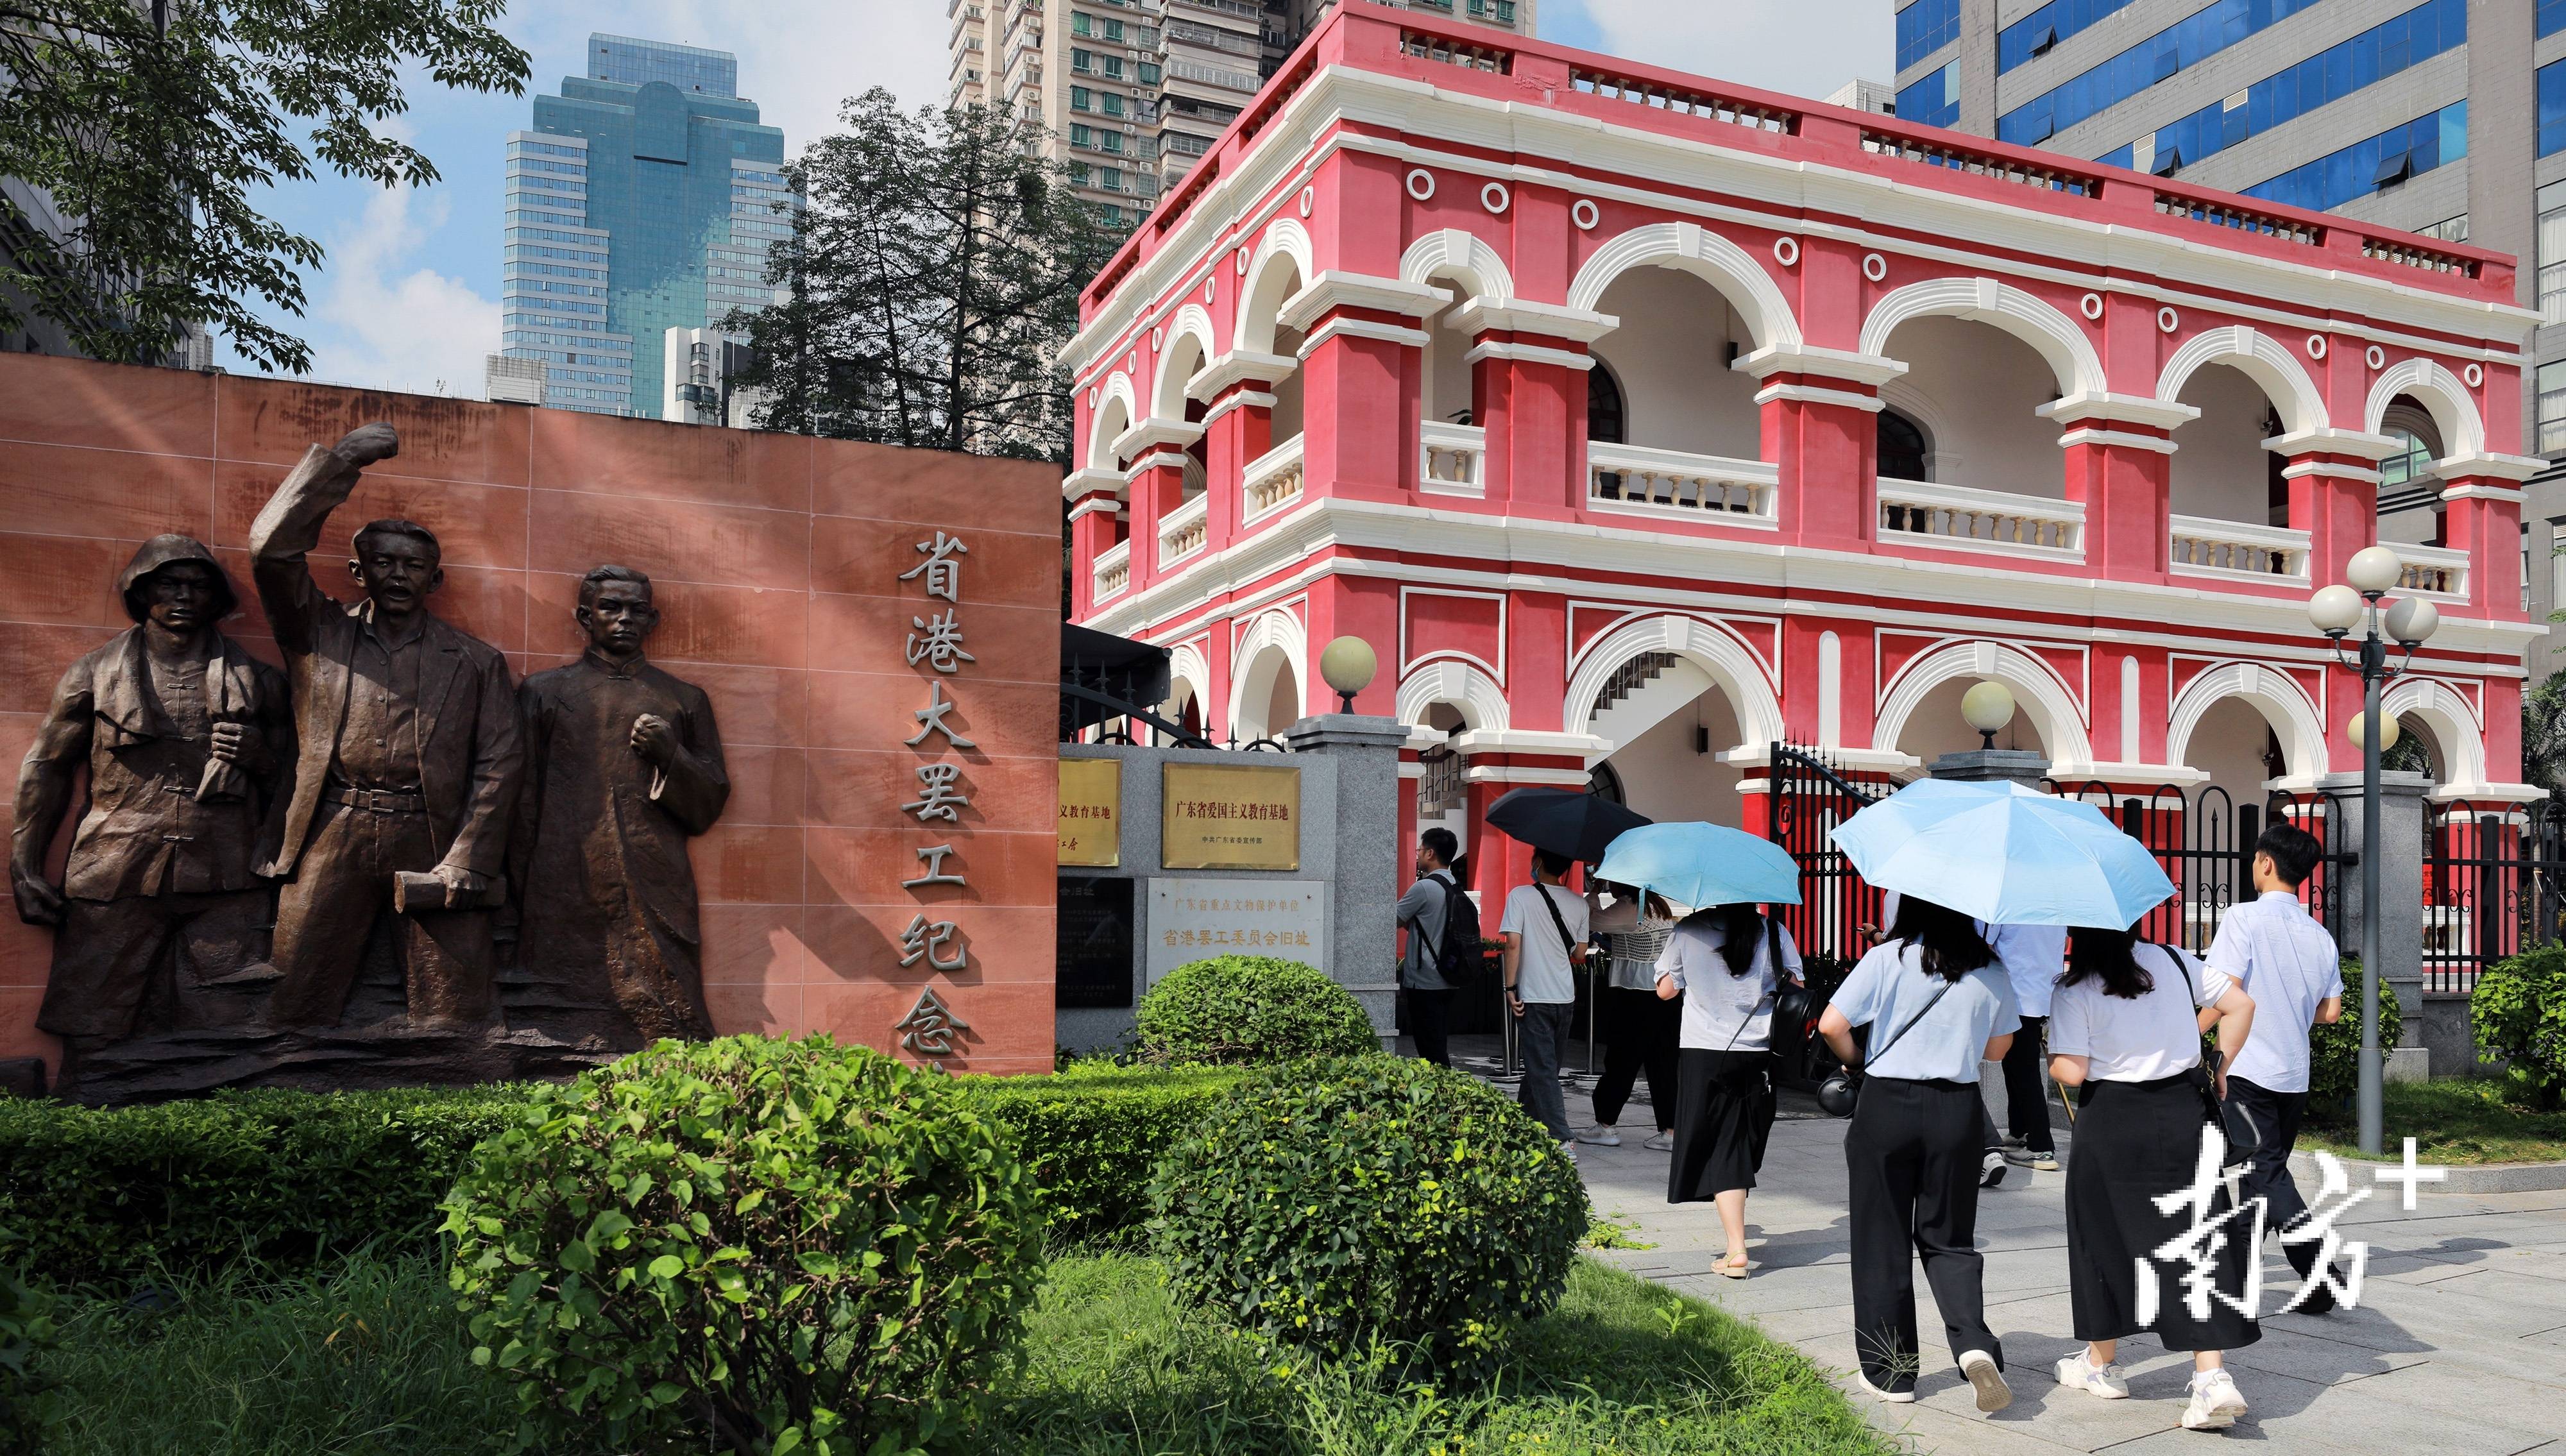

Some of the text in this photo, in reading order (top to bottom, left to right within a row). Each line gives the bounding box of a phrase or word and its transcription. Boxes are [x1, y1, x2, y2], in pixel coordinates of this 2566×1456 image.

[896, 531, 974, 1074] 省港大罢工纪念
[1176, 801, 1288, 820] 广东省爱国主义教育基地
[1059, 805, 1110, 819] 义教育基地
[1175, 899, 1299, 911] 广东省重点文物保护单位
[1163, 929, 1310, 947] 省港罢工委员会旧址
